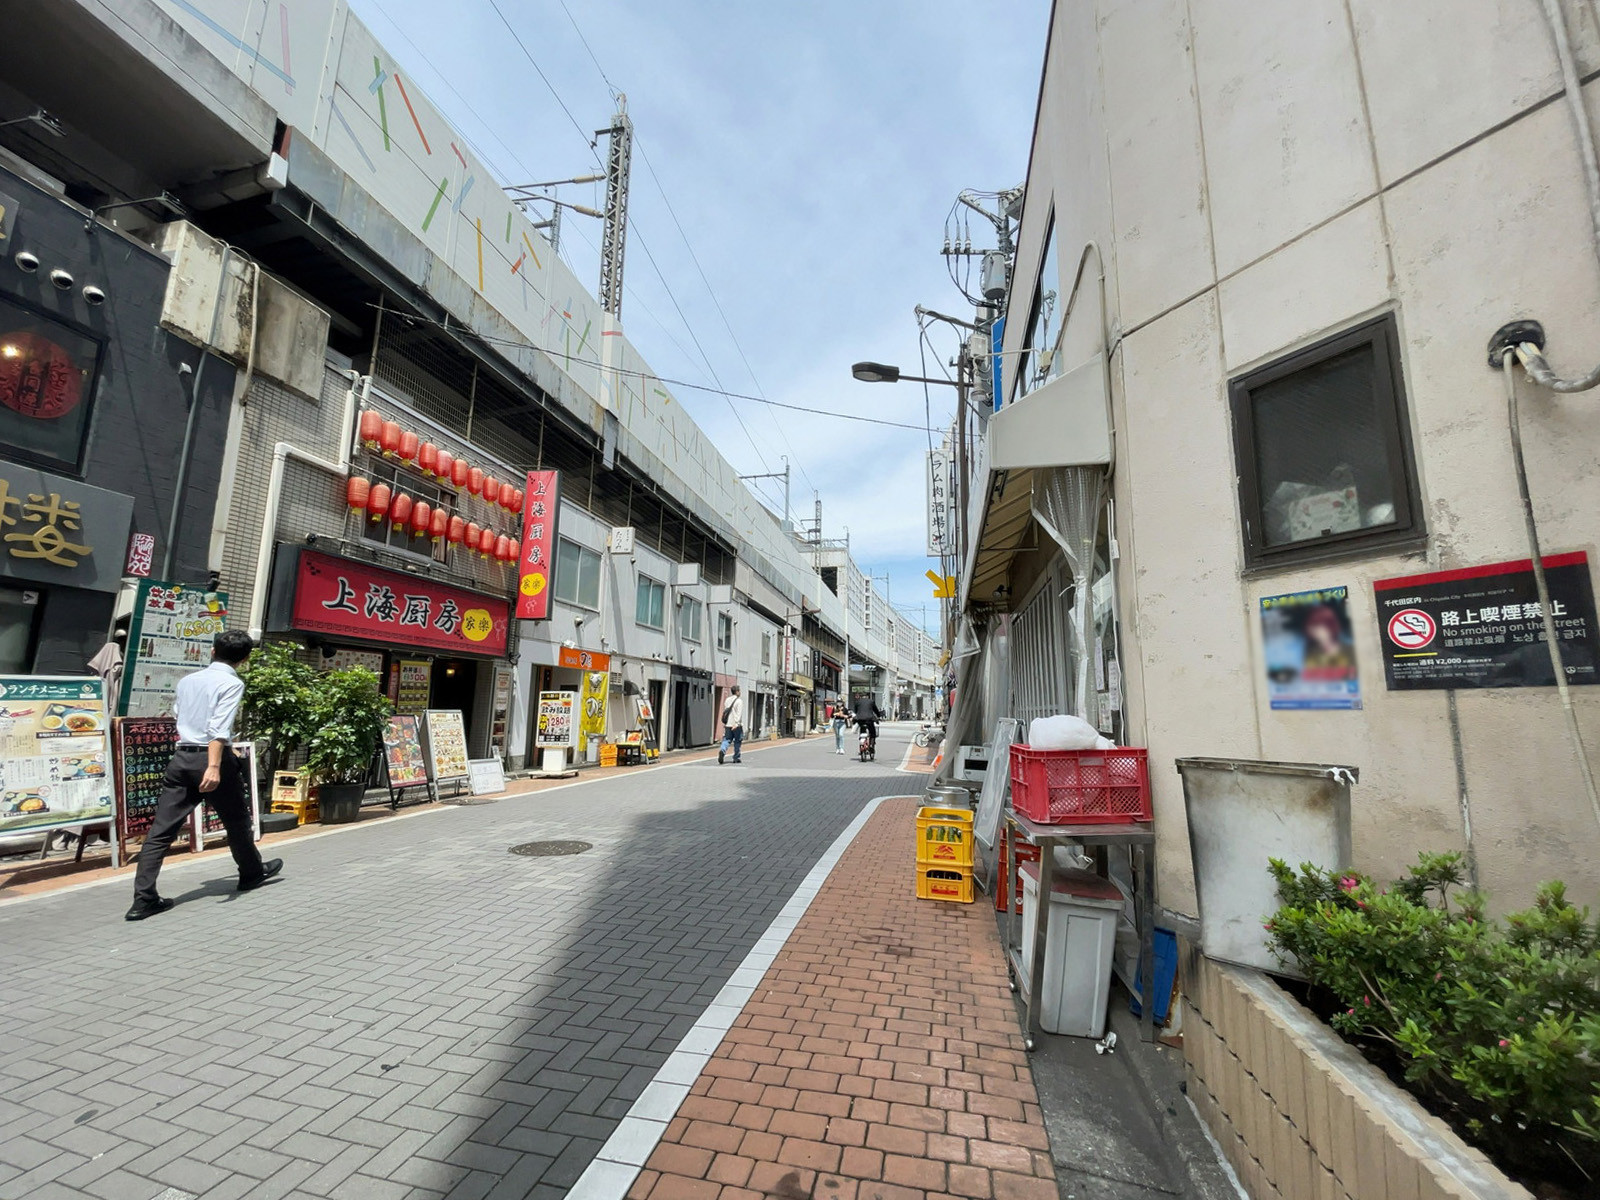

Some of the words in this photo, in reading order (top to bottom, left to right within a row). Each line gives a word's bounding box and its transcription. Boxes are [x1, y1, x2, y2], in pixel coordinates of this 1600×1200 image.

[528, 481, 546, 564] 上海厨房
[322, 577, 462, 635] 上海厨房
[1441, 600, 1567, 626] 路上喫煙禁止
[1443, 628, 1458, 637] No
[1460, 624, 1507, 634] smoking
[1527, 620, 1547, 630] the
[1553, 617, 1586, 627] treet
[8, 684, 78, 694] ランチメニュー
